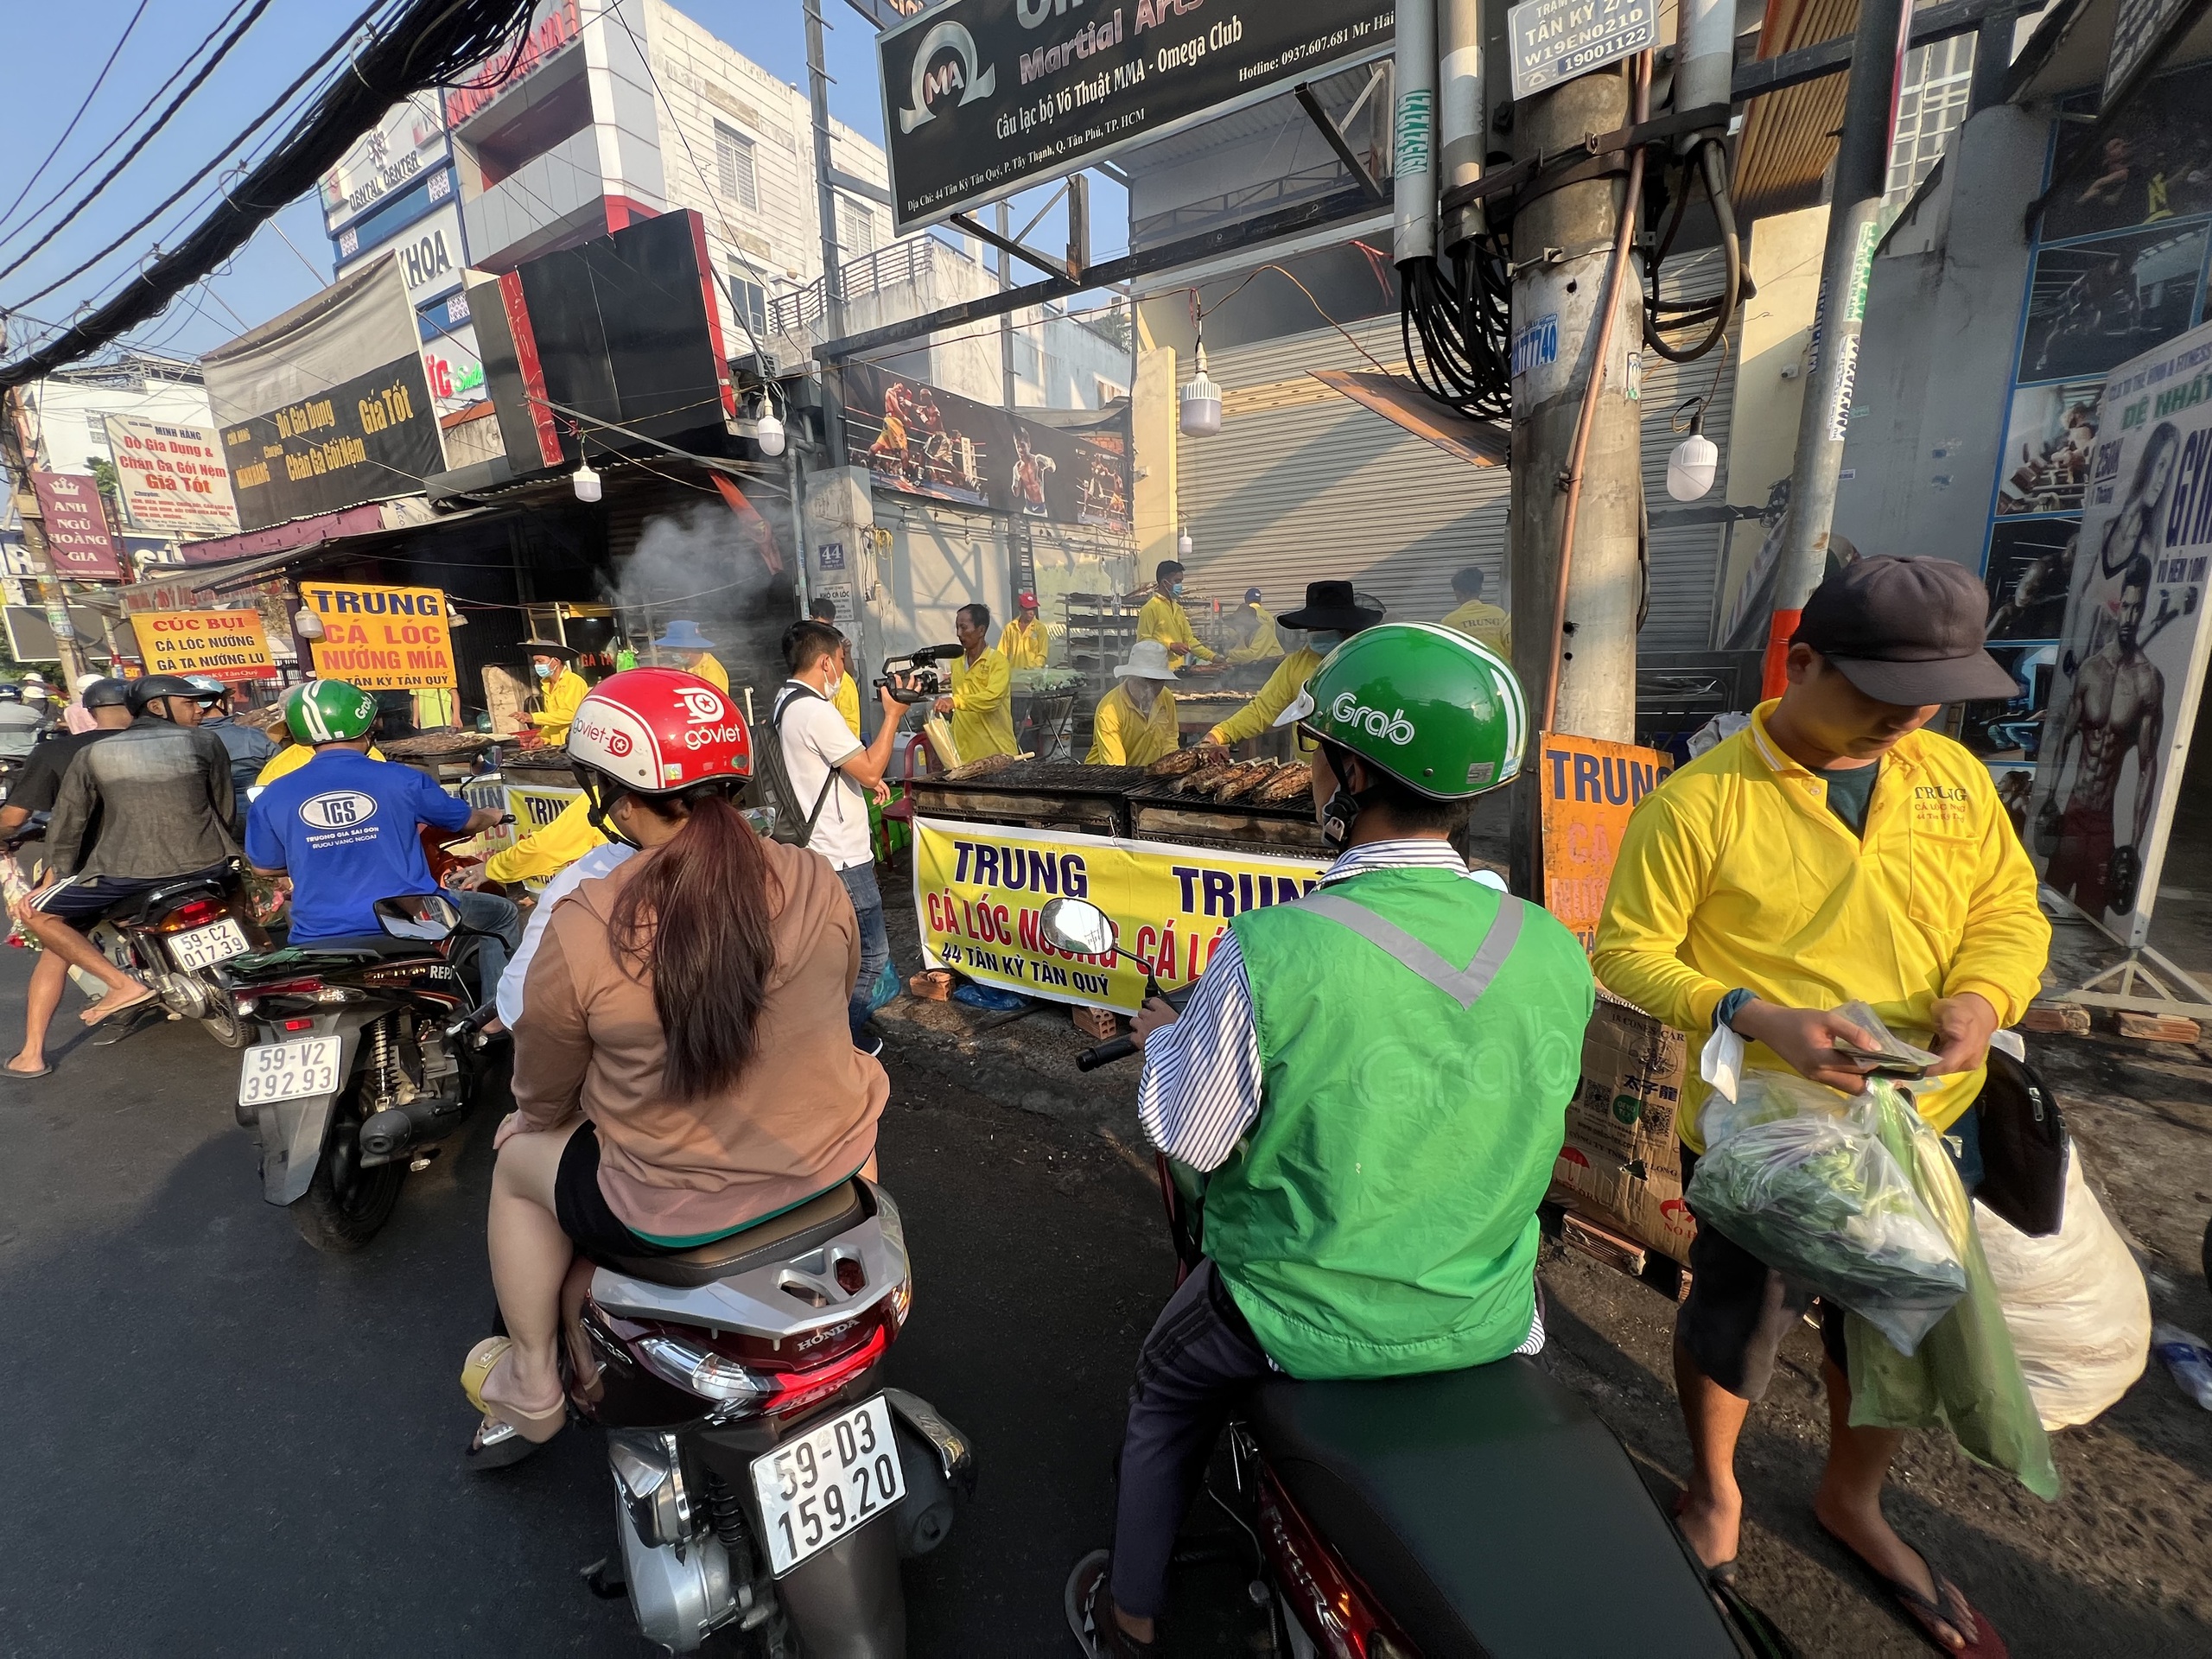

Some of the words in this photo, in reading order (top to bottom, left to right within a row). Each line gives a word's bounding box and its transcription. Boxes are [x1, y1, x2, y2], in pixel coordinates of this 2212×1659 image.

[1525, 16, 1563, 47] TÂN
[1604, 0, 1637, 14] 2/
[1019, 8, 1123, 85] Martial
[1238, 58, 1280, 82] Hotline:
[1281, 28, 1349, 66] 0937.607.681
[1351, 22, 1371, 39] Mr
[1564, 28, 1646, 71] 19001122
[996, 111, 1017, 140] Câu
[1020, 106, 1037, 135] lạc
[1039, 97, 1054, 125] bộ
[1056, 86, 1072, 115] Võ
[1074, 73, 1111, 105] Thuật
[1114, 58, 1146, 92] MMA
[1157, 35, 1206, 73] Omega
[1209, 15, 1243, 52] Club
[935, 188, 944, 200] 44
[944, 182, 958, 197] Tân
[969, 174, 984, 188] Tân
[1004, 162, 1012, 173] P.
[1012, 155, 1027, 170] Tây
[1028, 143, 1055, 163] Thạnh,
[1056, 140, 1066, 154] Q.
[1067, 134, 1084, 149] Tân
[1084, 124, 1104, 141] Phú,
[1105, 119, 1120, 133] TP.
[1121, 108, 1146, 128] HCM
[349, 176, 385, 212] DENTAL
[383, 150, 422, 187] CENTER
[289, 406, 309, 435] Gia
[305, 399, 335, 432] Dụng
[381, 378, 414, 425] Tốt
[155, 426, 177, 437] MINH
[145, 439, 167, 452] Gia
[169, 442, 201, 458] Dụng
[205, 448, 213, 458] &
[157, 459, 173, 472] Ga
[181, 476, 213, 494] Tốt
[54, 501, 88, 512] ANH
[48, 531, 108, 545] HOÀNG
[822, 545, 842, 560] 44
[68, 551, 98, 562] GIA
[311, 590, 439, 616] TRUNG
[152, 617, 200, 632] CÚC
[206, 618, 245, 632] BỤI
[325, 619, 368, 645] CÁ
[384, 619, 442, 645] LÓC
[1462, 617, 1500, 629] TRUNG
[155, 637, 175, 652] CÁ
[179, 637, 205, 650] LÓC
[208, 635, 255, 648] NƯỚNG
[322, 645, 401, 671] NƯỚNG
[406, 645, 448, 670] MÍA
[156, 657, 177, 671] GÀ
[179, 658, 196, 669] TA
[199, 654, 246, 667] NƯỚNG
[249, 652, 265, 664] LU
[346, 675, 372, 688] TÂN
[377, 674, 392, 687] KỲ
[397, 674, 422, 685] TÂN
[426, 671, 448, 685] QUÝ
[354, 696, 372, 721] Grab
[1332, 691, 1415, 746] Grab
[684, 724, 741, 751] goviet
[316, 796, 357, 825] TGS
[1567, 811, 1611, 865] CÁ
[954, 841, 1089, 899] TRUNG
[1172, 866, 1325, 918] TRUN
[181, 925, 231, 950] 59-C2
[927, 891, 957, 934] CÁ
[965, 893, 1012, 946] LÓC
[1136, 919, 1177, 980] CÁ
[1188, 923, 1222, 982] LÓ
[1577, 925, 1595, 955] TÂ
[184, 938, 244, 968] 017.39
[941, 942, 963, 963] 44
[966, 945, 999, 971] TÂN
[1004, 950, 1025, 980] KỲ
[1032, 959, 1068, 987] TÂN
[1073, 968, 1109, 997] QUÝ
[259, 1043, 326, 1073] 59-V2
[247, 1066, 332, 1100] 392.93
[1664, 1222, 1683, 1236] NO
[797, 1318, 861, 1352] HONDA
[775, 1408, 876, 1502] 59-D3
[778, 1452, 897, 1560] 159.20
